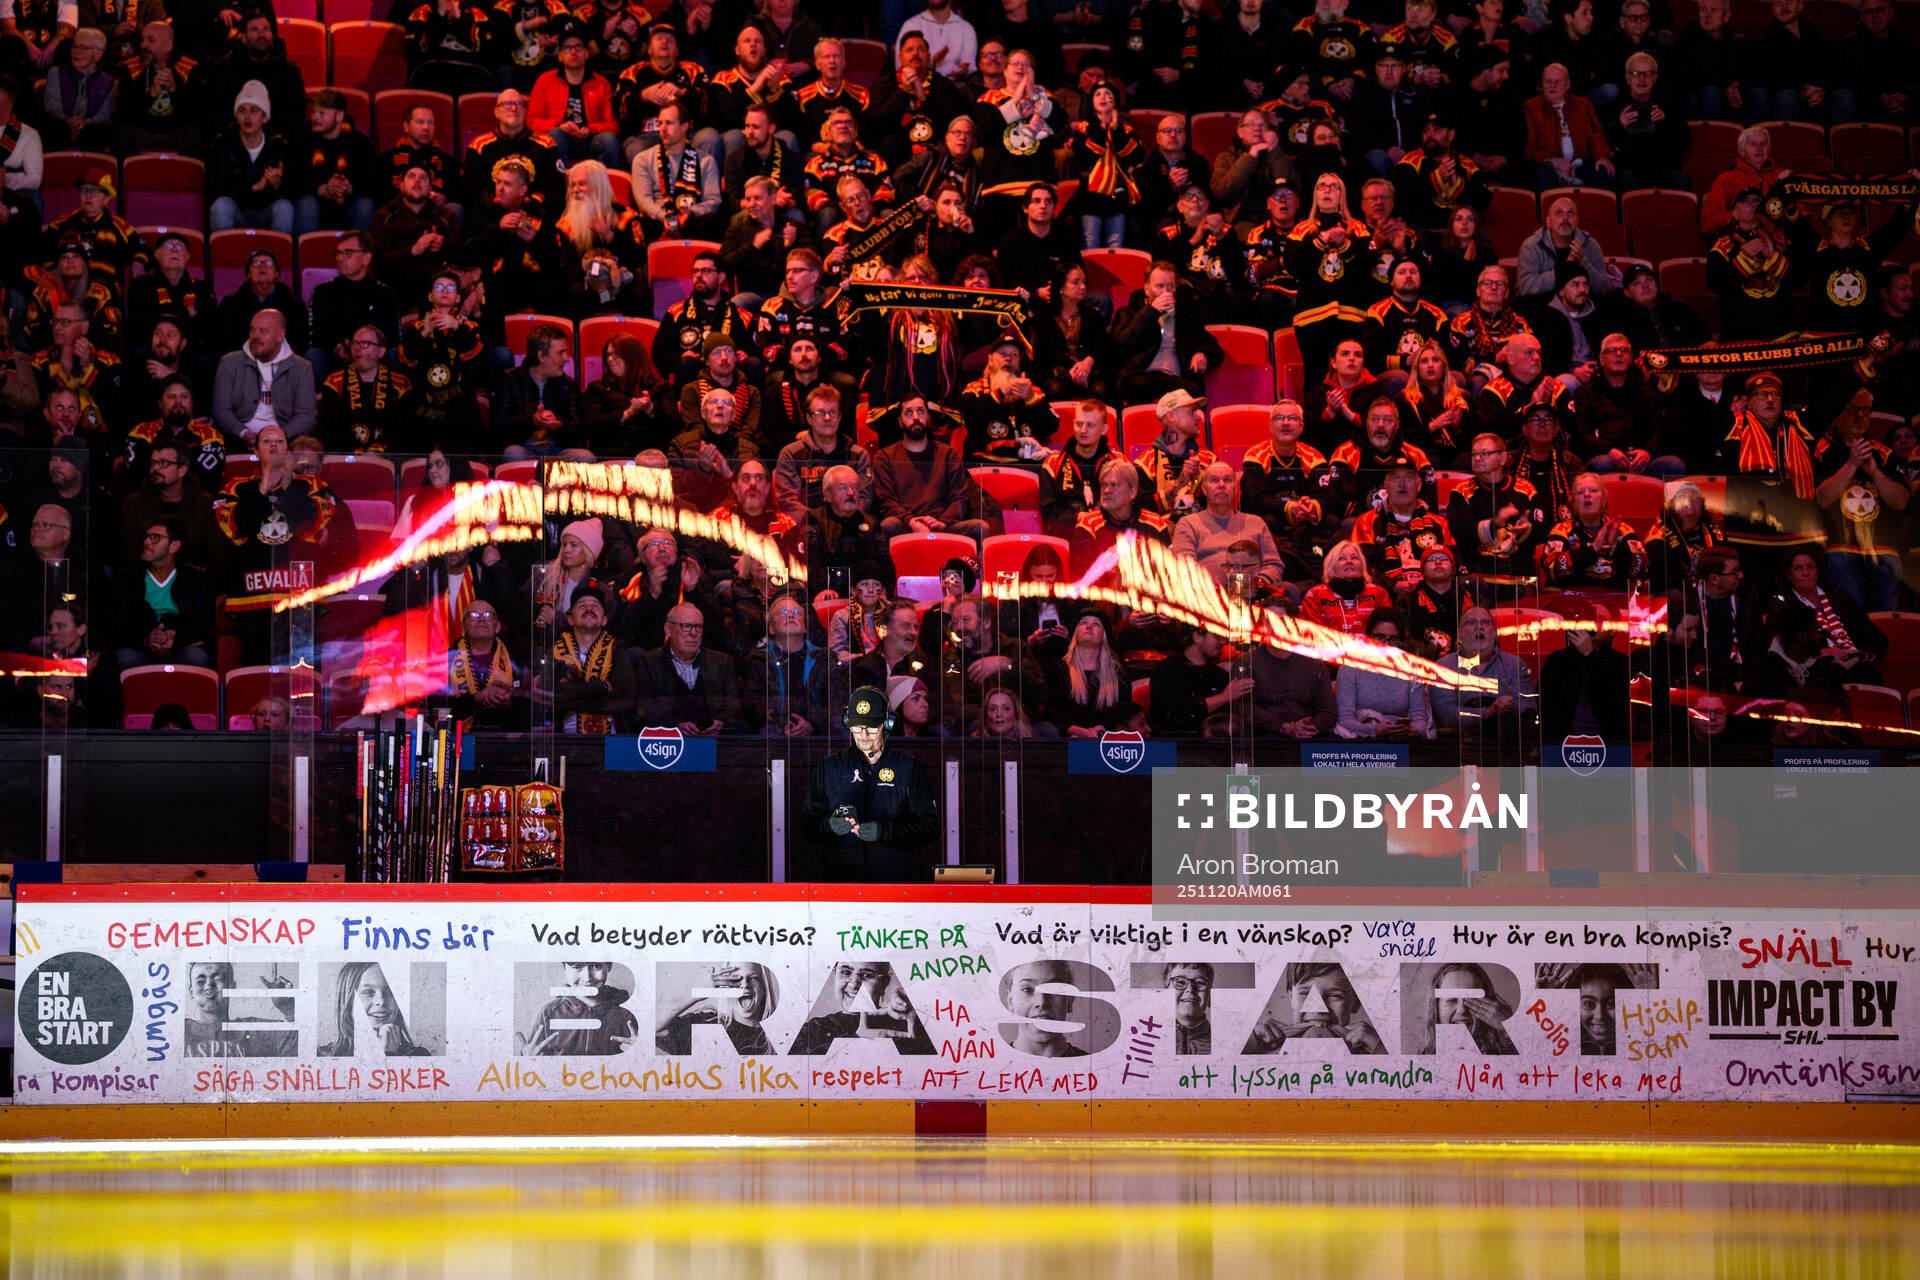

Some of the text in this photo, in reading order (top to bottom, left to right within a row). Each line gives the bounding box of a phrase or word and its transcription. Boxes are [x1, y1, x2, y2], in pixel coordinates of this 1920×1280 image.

[850, 227, 890, 258] KLUBB
[1679, 337, 1863, 364] EN STOR KLUBB FÖR ALLA
[244, 571, 310, 593] GEVALIA
[645, 741, 677, 760] 4Sign
[1107, 745, 1138, 764] 4Sign
[1340, 752, 1350, 760] PÅ
[1568, 750, 1600, 768] 4Sign
[1813, 757, 1822, 765] PÅ
[107, 917, 316, 949] GEMENSKAP
[342, 917, 431, 952] Finns
[531, 922, 817, 950] Vad betyder rättvisa?
[837, 924, 968, 951] TÄNKER PÅ
[995, 922, 1353, 952] Vad är viktigt i en vänskap?
[1453, 925, 1732, 952] Hur är en bra kompis?
[1380, 937, 1436, 957] snäll
[1739, 928, 1853, 968] SNÄLL
[1866, 937, 1915, 962] Hur
[909, 955, 991, 981] ANDRA
[38, 972, 69, 995] EN
[38, 997, 87, 1020] BRA
[142, 961, 179, 1063] umgås
[184, 960, 1659, 1057] EN BRA START
[934, 998, 972, 1026] HA
[1708, 979, 1898, 1027] IMPACT BY
[38, 1021, 113, 1045] START
[1526, 998, 1569, 1056] Rolig
[1783, 1030, 1824, 1045] SHL
[940, 1029, 995, 1064] NÅN
[1121, 1015, 1163, 1085] Tillit
[51, 1066, 160, 1097] kompisar
[194, 1063, 450, 1092] SÄGA SNÄLLA SAKER
[477, 1059, 799, 1093] Alla behandlas lika
[812, 1065, 903, 1087] respekt
[922, 1068, 1099, 1094] ATT LEKA MED
[1179, 1063, 1434, 1097] att lyssna på varandra
[1457, 1063, 1504, 1093] Nån
[1518, 1066, 1559, 1088] att
[1574, 1065, 1622, 1093] leka
